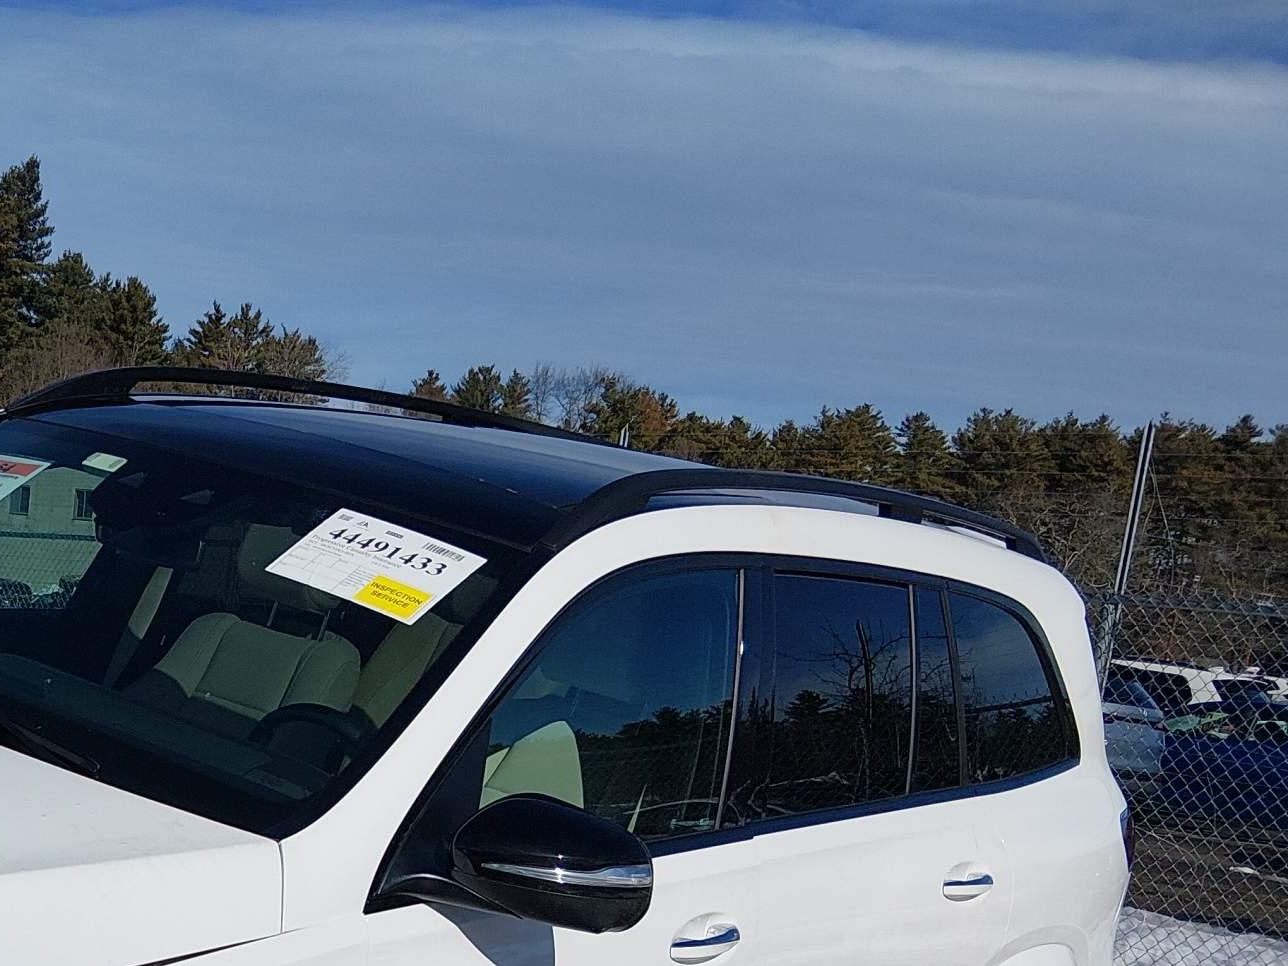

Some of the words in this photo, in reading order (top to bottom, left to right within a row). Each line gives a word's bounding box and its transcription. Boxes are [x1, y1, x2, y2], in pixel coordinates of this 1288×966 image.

[329, 527, 448, 576] 44491433
[370, 590, 410, 609] SERVICE
[371, 582, 423, 606] INSPECTION
